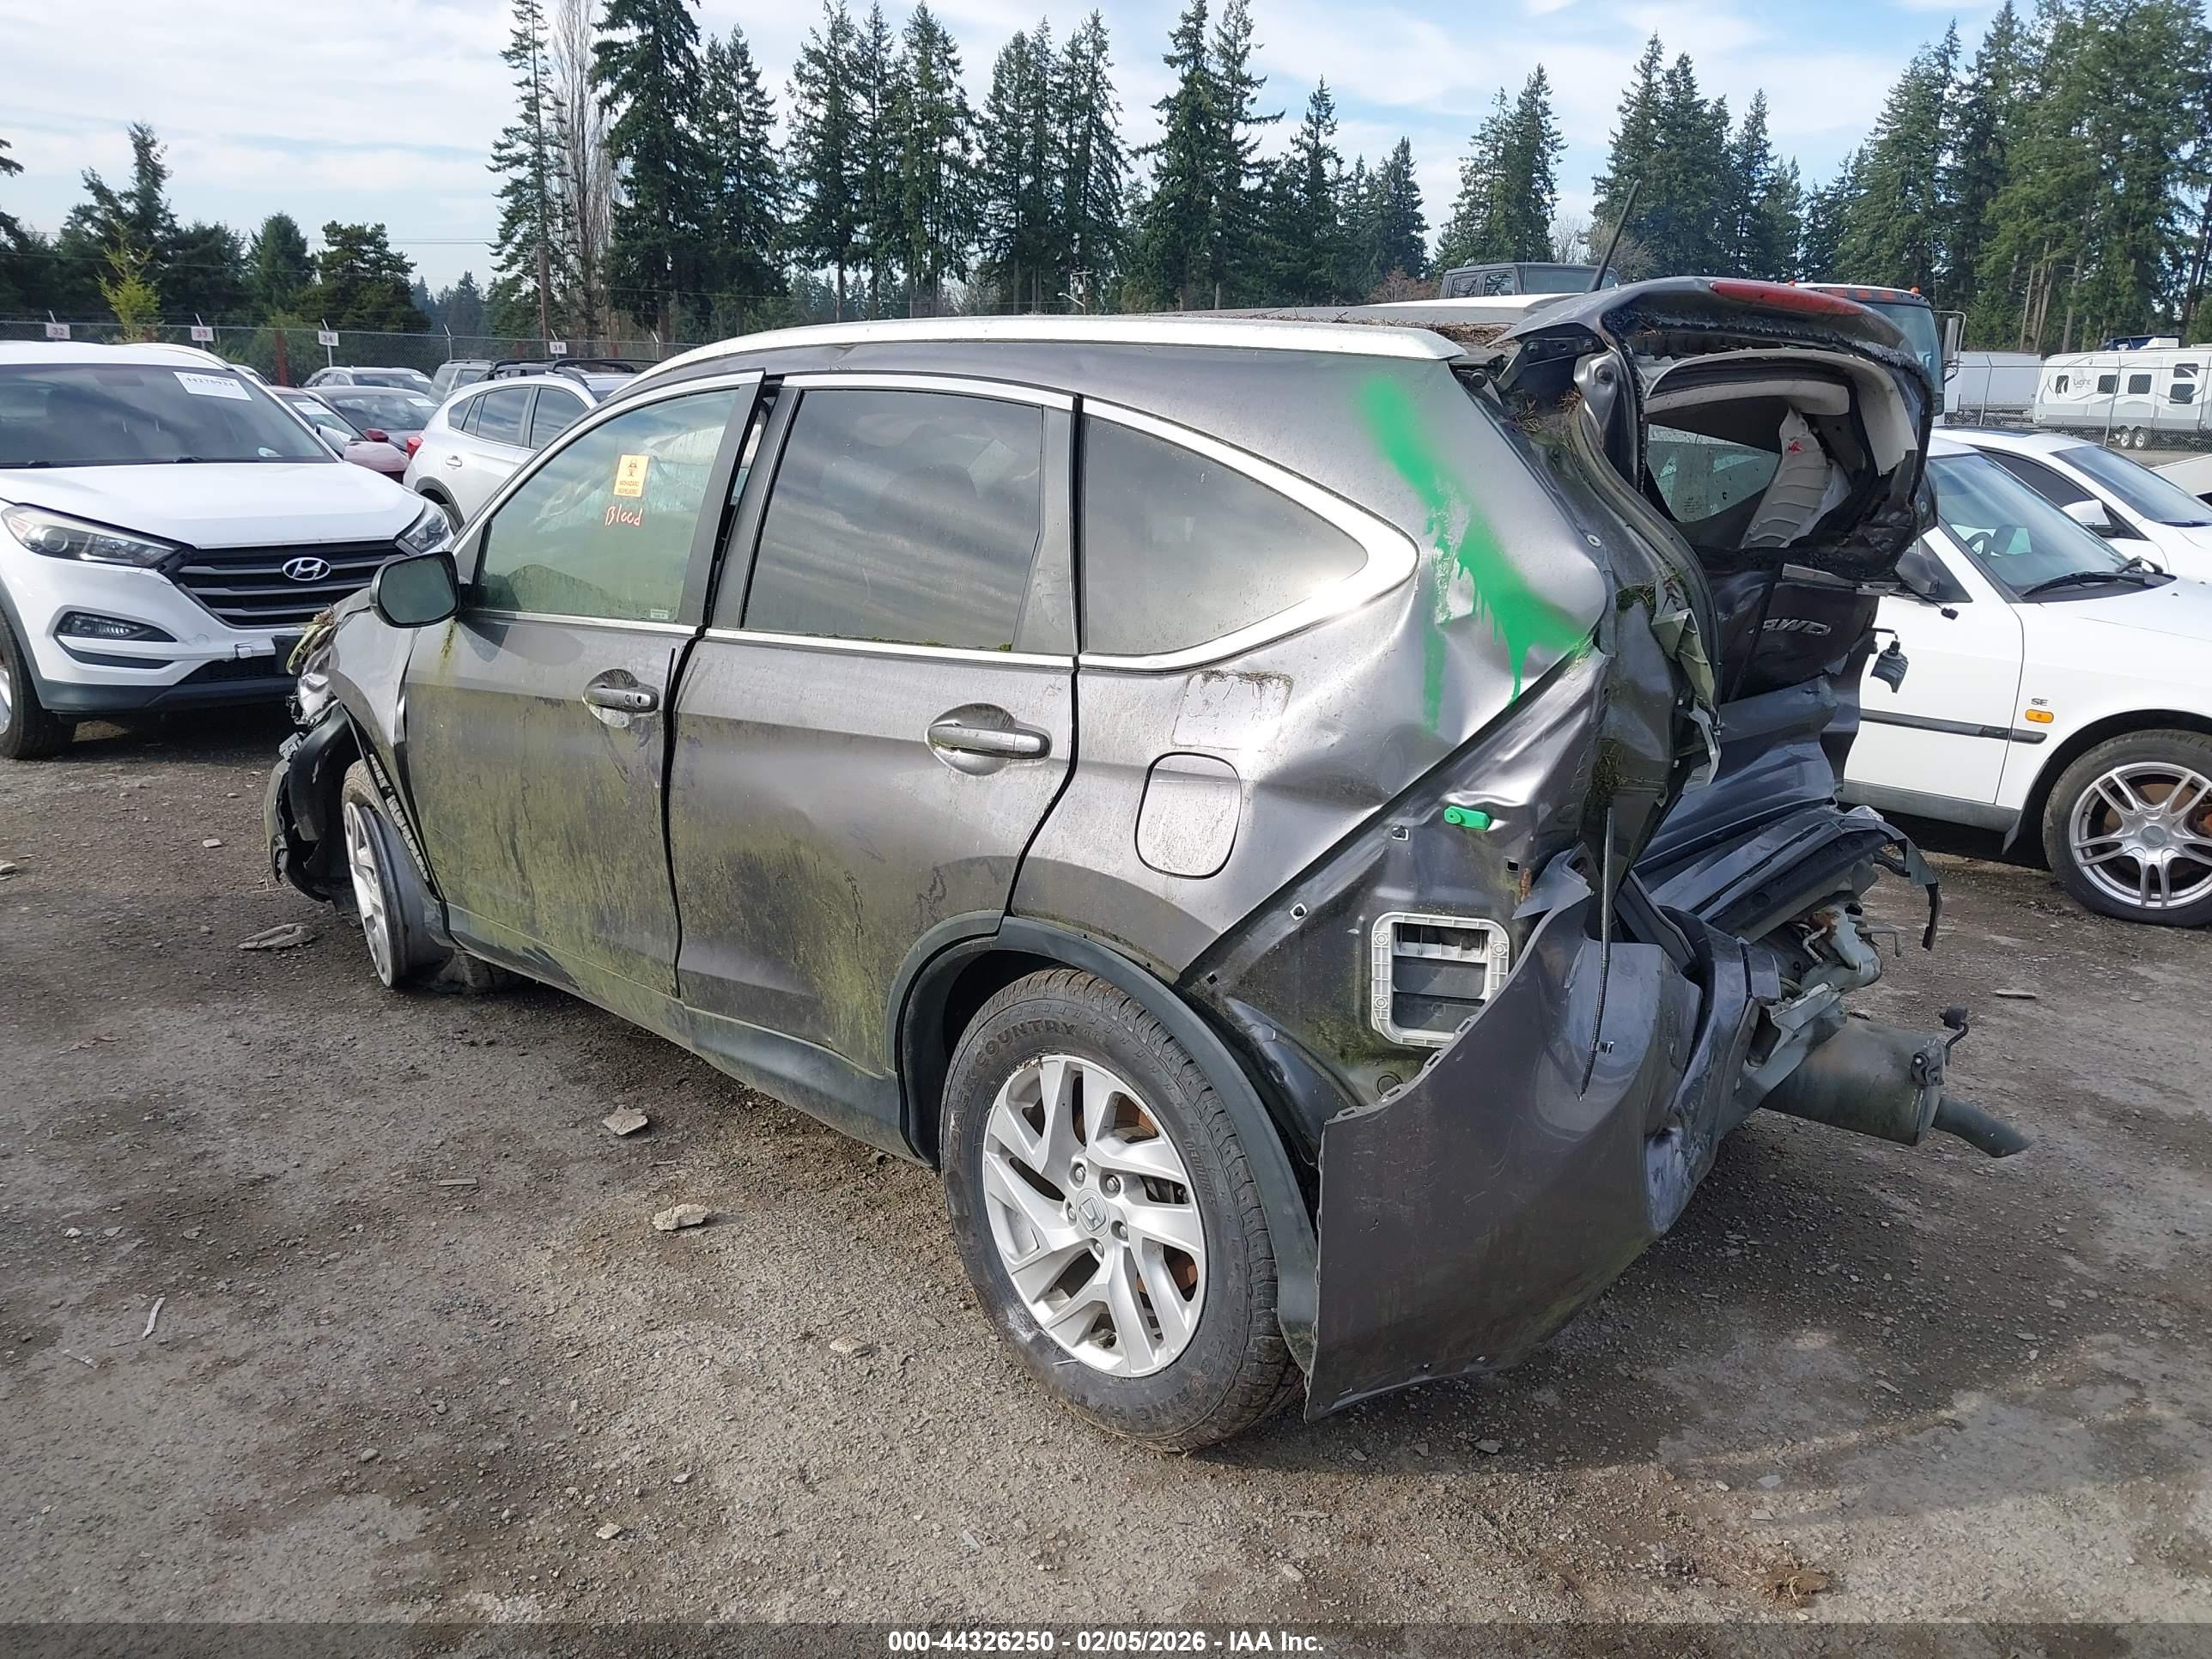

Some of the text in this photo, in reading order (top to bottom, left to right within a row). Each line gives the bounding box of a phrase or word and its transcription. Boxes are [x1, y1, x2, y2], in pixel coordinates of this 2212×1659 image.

[196, 329, 208, 338] 33
[605, 503, 643, 526] Blood
[1747, 618, 1831, 635] AWD
[2031, 697, 2049, 707] SE
[975, 1018, 1079, 1067] COUNTRY
